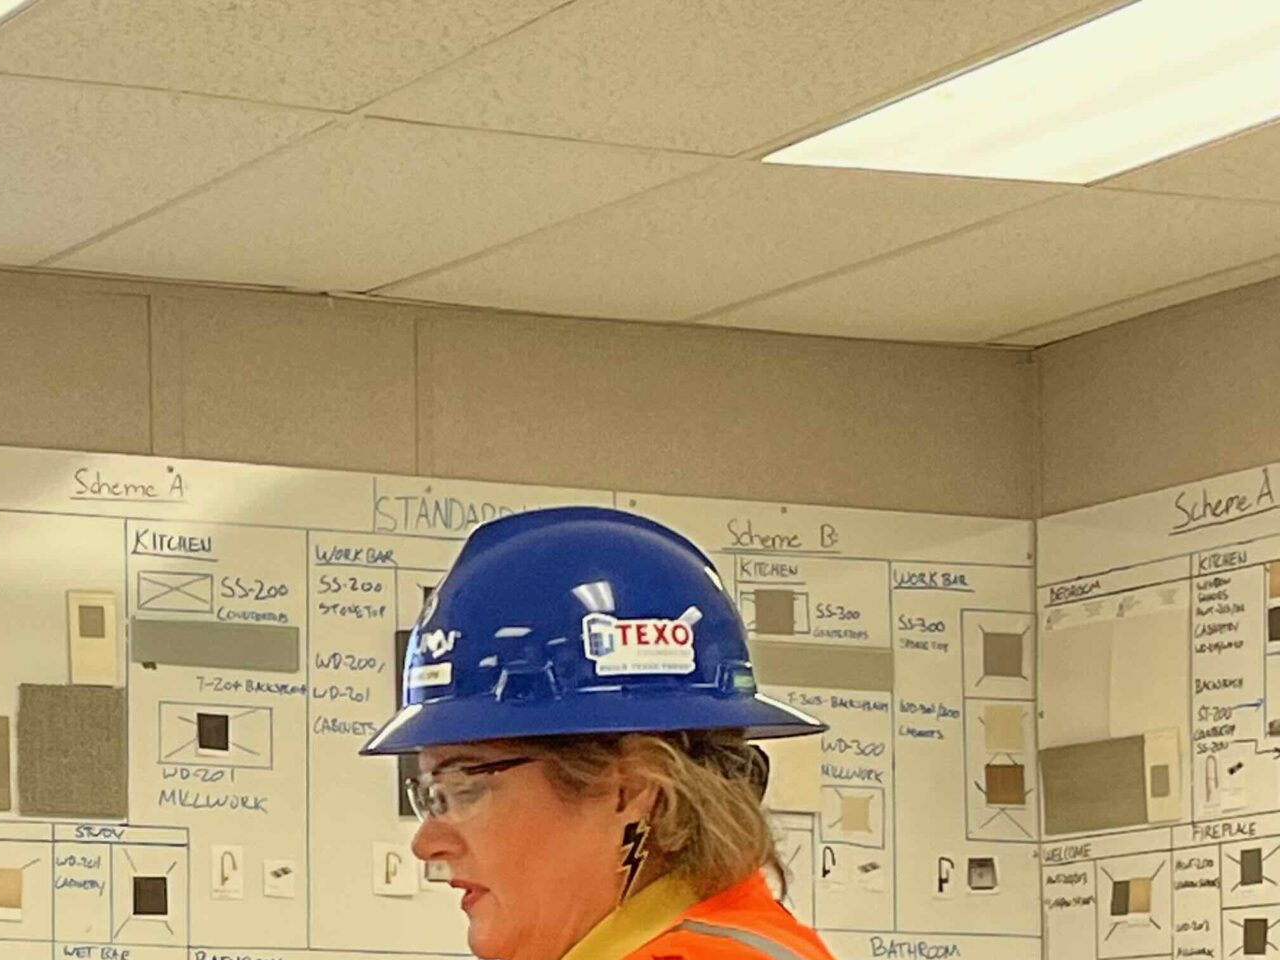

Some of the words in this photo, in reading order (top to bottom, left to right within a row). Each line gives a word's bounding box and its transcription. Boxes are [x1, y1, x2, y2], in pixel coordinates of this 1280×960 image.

[74, 467, 159, 497] Scheme
[168, 473, 185, 494] A
[1173, 490, 1253, 529] Scheme
[1257, 468, 1274, 505] A
[134, 529, 212, 552] KITCHEN
[727, 519, 802, 548] Scheme
[315, 545, 365, 563] WORK
[367, 549, 397, 564] BAR
[740, 560, 799, 576] KITCHEN
[893, 570, 937, 587] WORK
[941, 573, 968, 587] BAR
[221, 576, 289, 600] SS-200
[318, 575, 383, 594] SS-200
[816, 603, 861, 621] SS-300
[898, 614, 946, 633] SS-300
[614, 624, 689, 646] TEXO
[158, 789, 269, 814] MILLWORK
[75, 823, 125, 840] STUDY
[1192, 821, 1257, 841] FIREPLACE
[870, 936, 961, 960] BATHROOM
